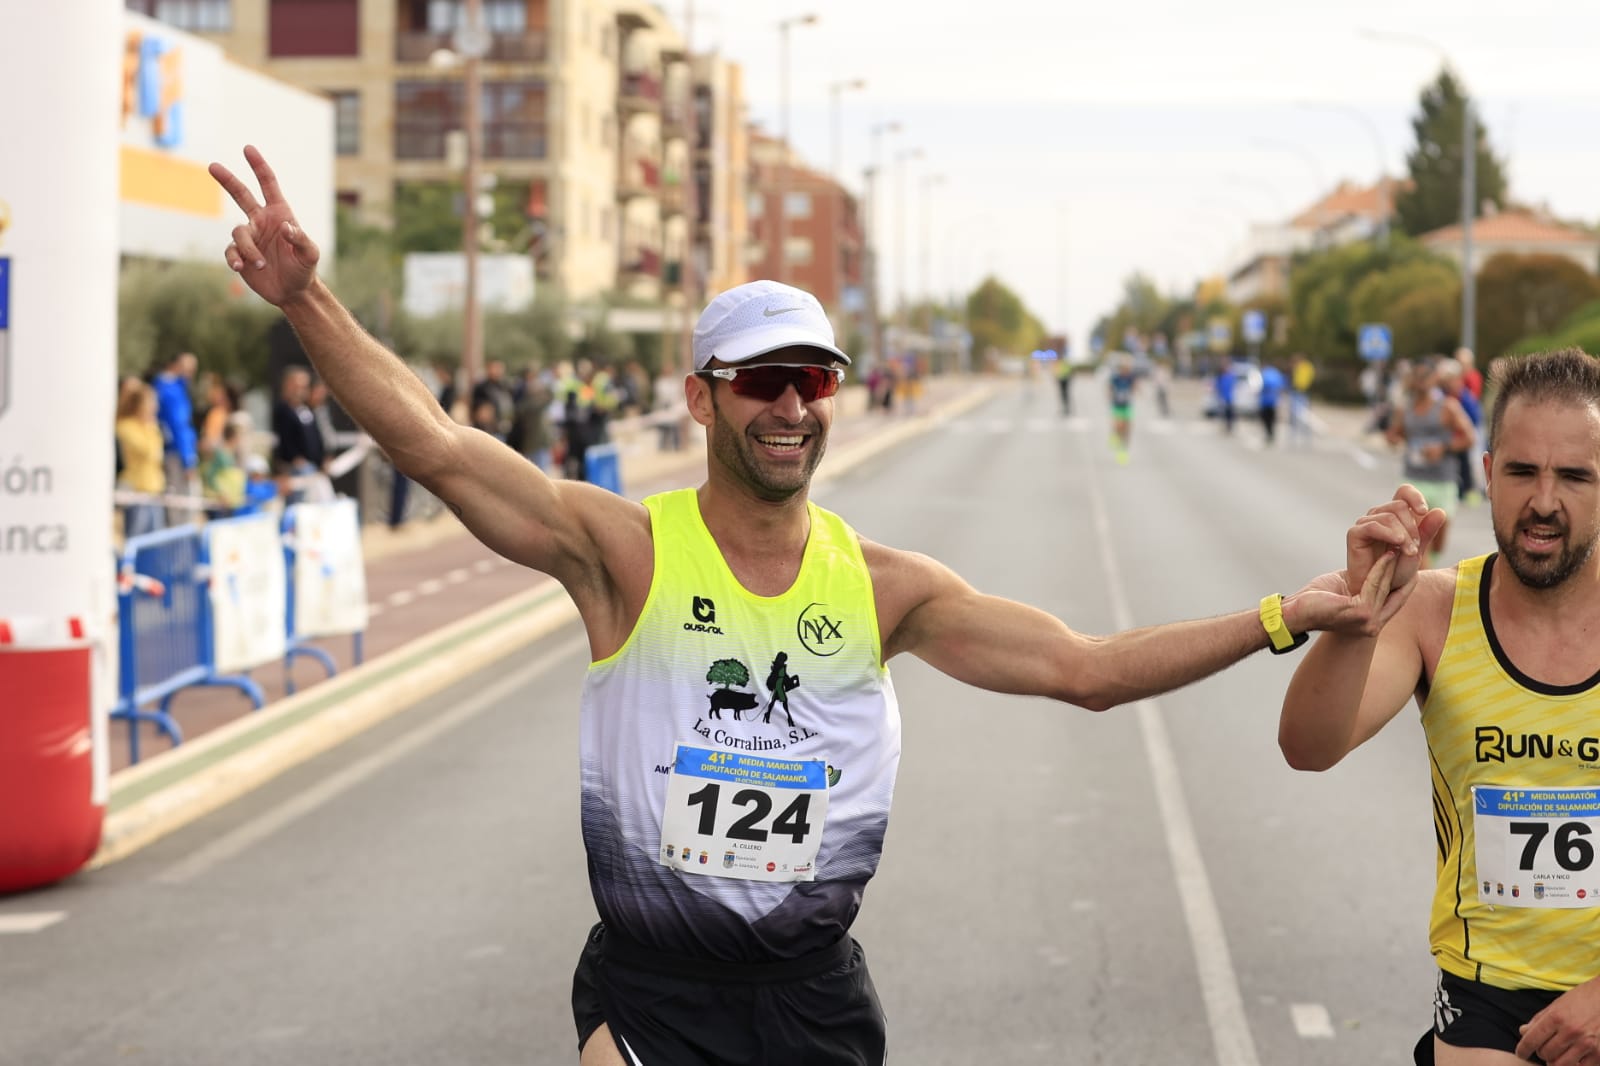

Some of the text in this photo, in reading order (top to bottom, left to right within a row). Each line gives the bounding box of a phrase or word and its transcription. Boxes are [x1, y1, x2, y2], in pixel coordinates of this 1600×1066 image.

[0, 454, 53, 495] ón
[0, 524, 68, 553] nca
[802, 615, 843, 645] NYX
[693, 717, 711, 738] La
[714, 729, 787, 751] Corralina,
[1558, 739, 1573, 757] &
[654, 764, 671, 775] AM
[701, 763, 808, 783] DIPUTACIÓN DE SALAMANCA
[738, 757, 765, 768] MEDIA
[766, 761, 803, 771] MARATÓN
[1497, 802, 1543, 811] DIPUTACIÓN
[1530, 792, 1557, 801] MEDIA
[1557, 791, 1597, 800] MARATÓN
[688, 783, 811, 844] 124
[1509, 821, 1594, 872] 76
